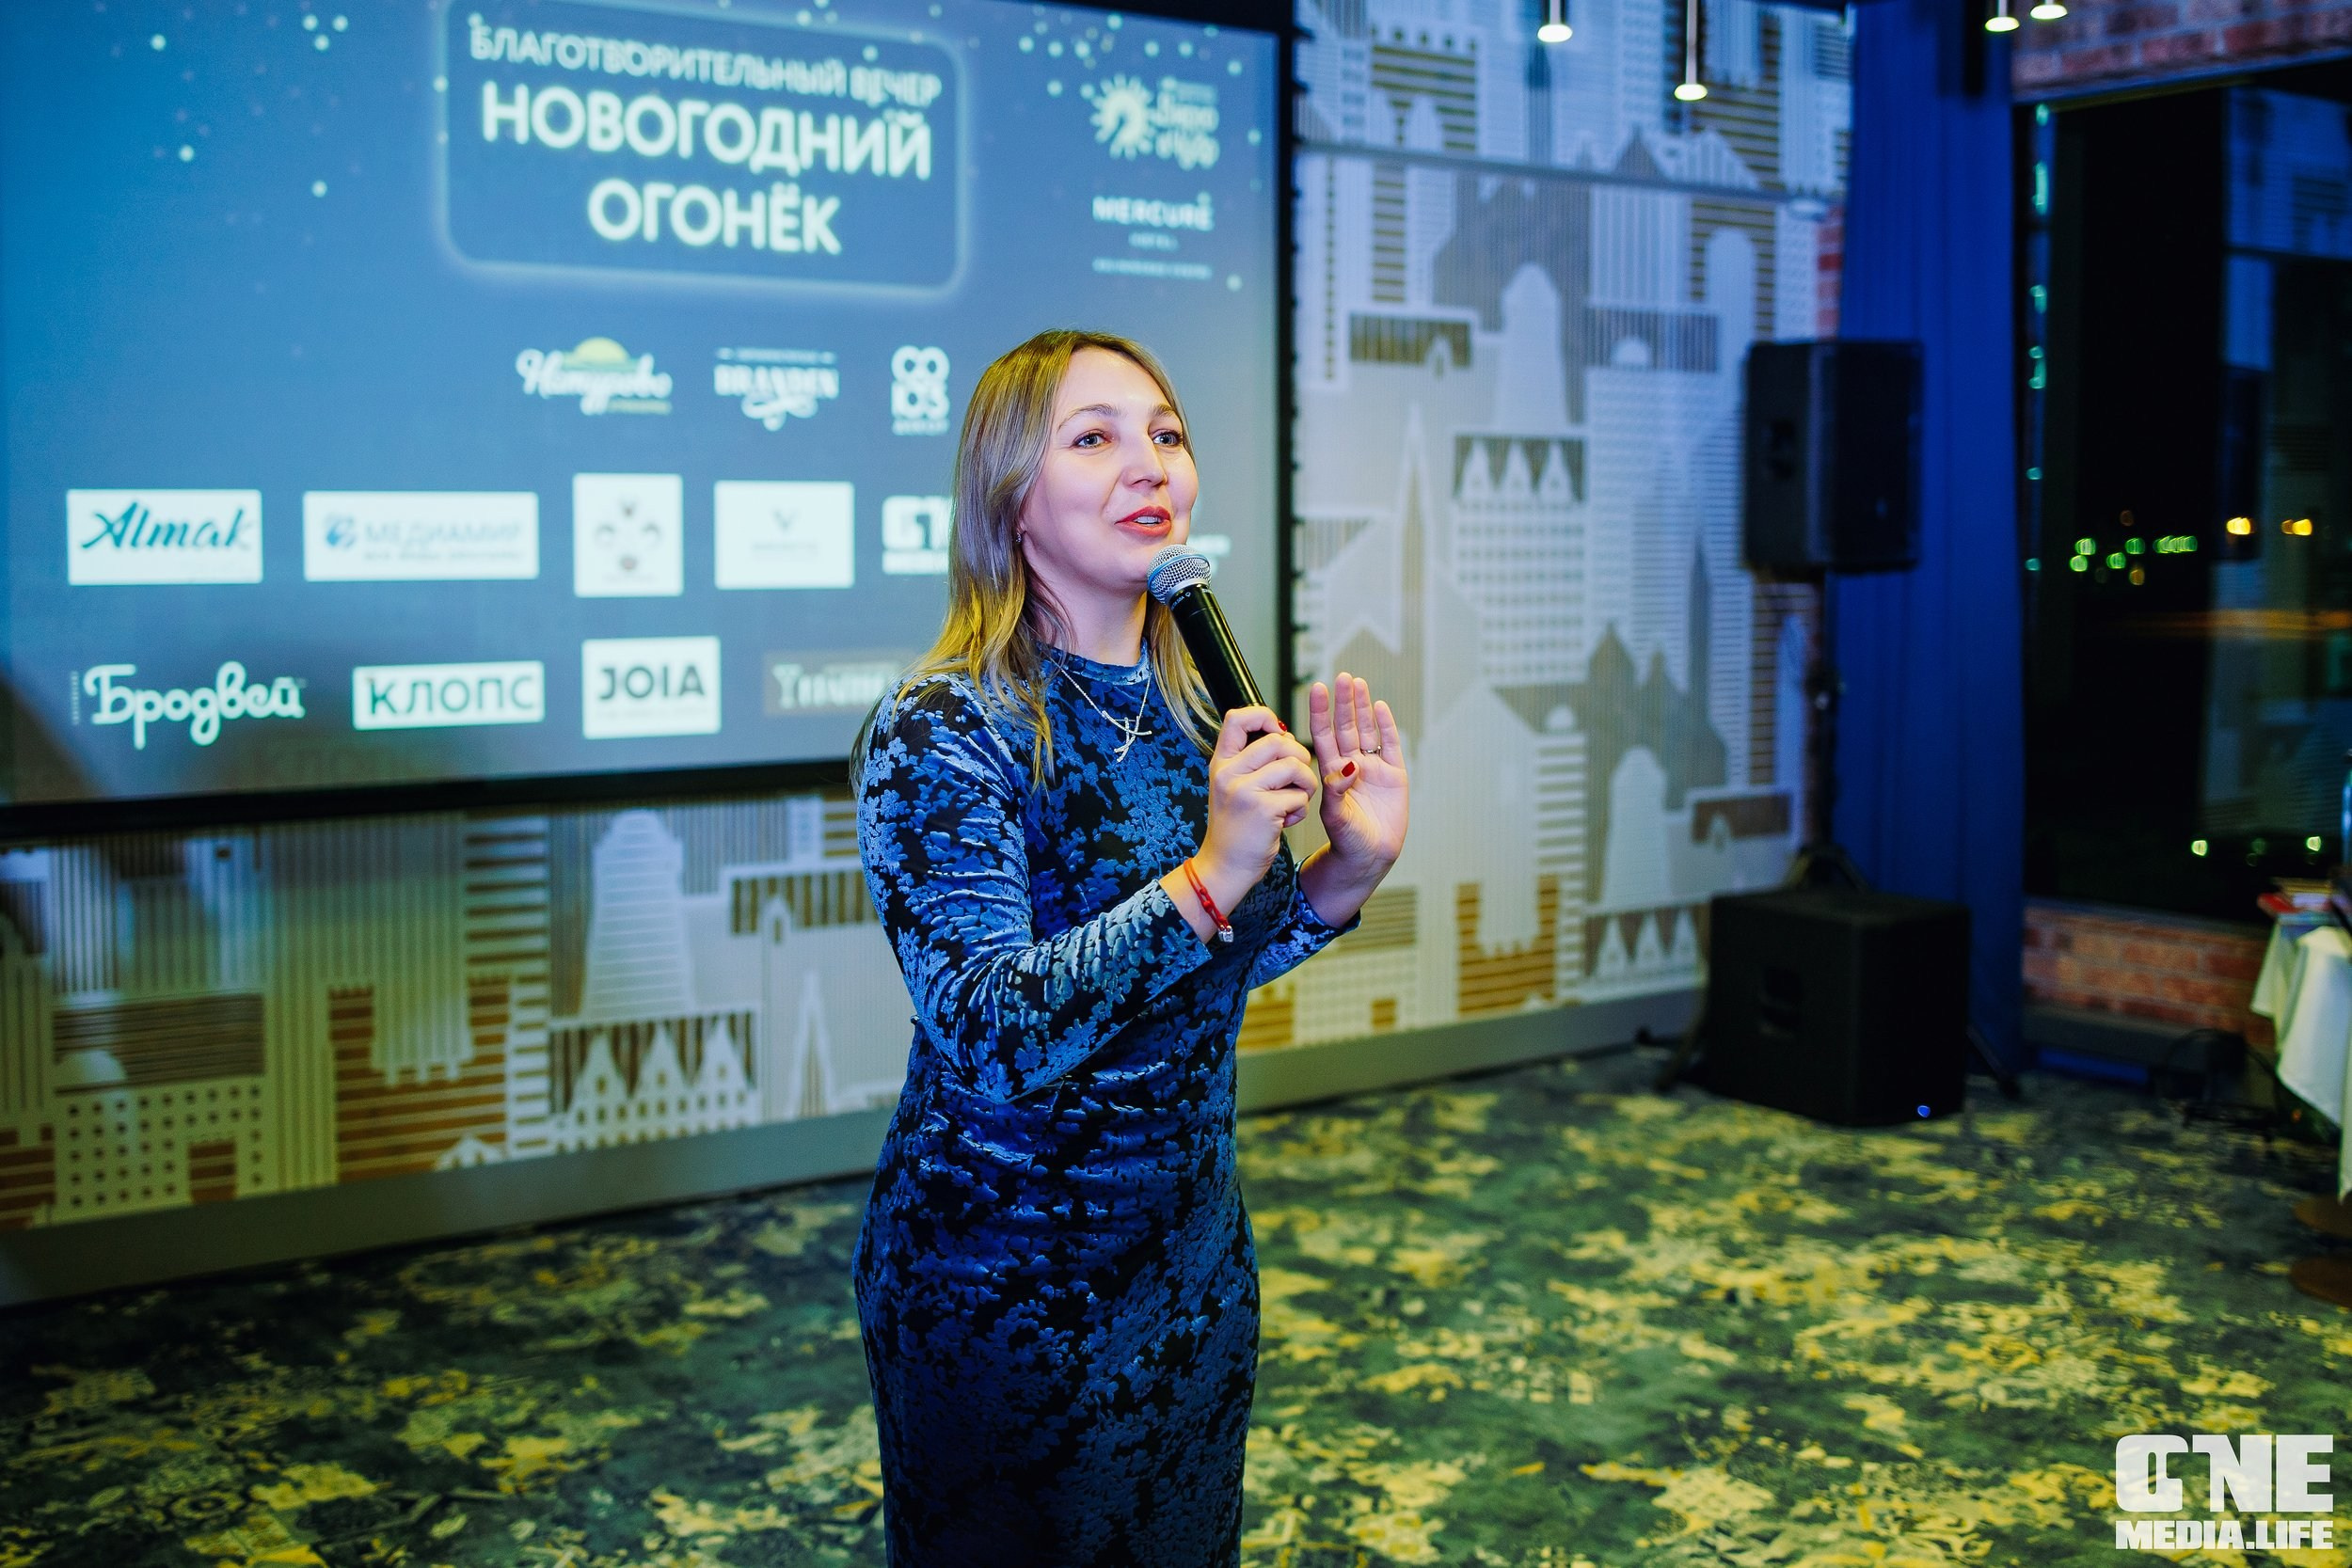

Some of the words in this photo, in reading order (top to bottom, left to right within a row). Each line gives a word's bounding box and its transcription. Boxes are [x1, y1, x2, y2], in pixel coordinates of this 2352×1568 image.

[470, 26, 847, 98] БЛАГОТВОРИТЕЛЬНЫЙ
[850, 65, 943, 107] ВЕЧЕР
[482, 80, 932, 181] НОВОГОДНИЙ
[588, 178, 843, 255] ОГОНЁК
[81, 500, 255, 551] Almak
[369, 673, 535, 715] КЛОПС
[599, 664, 706, 702] JOIA
